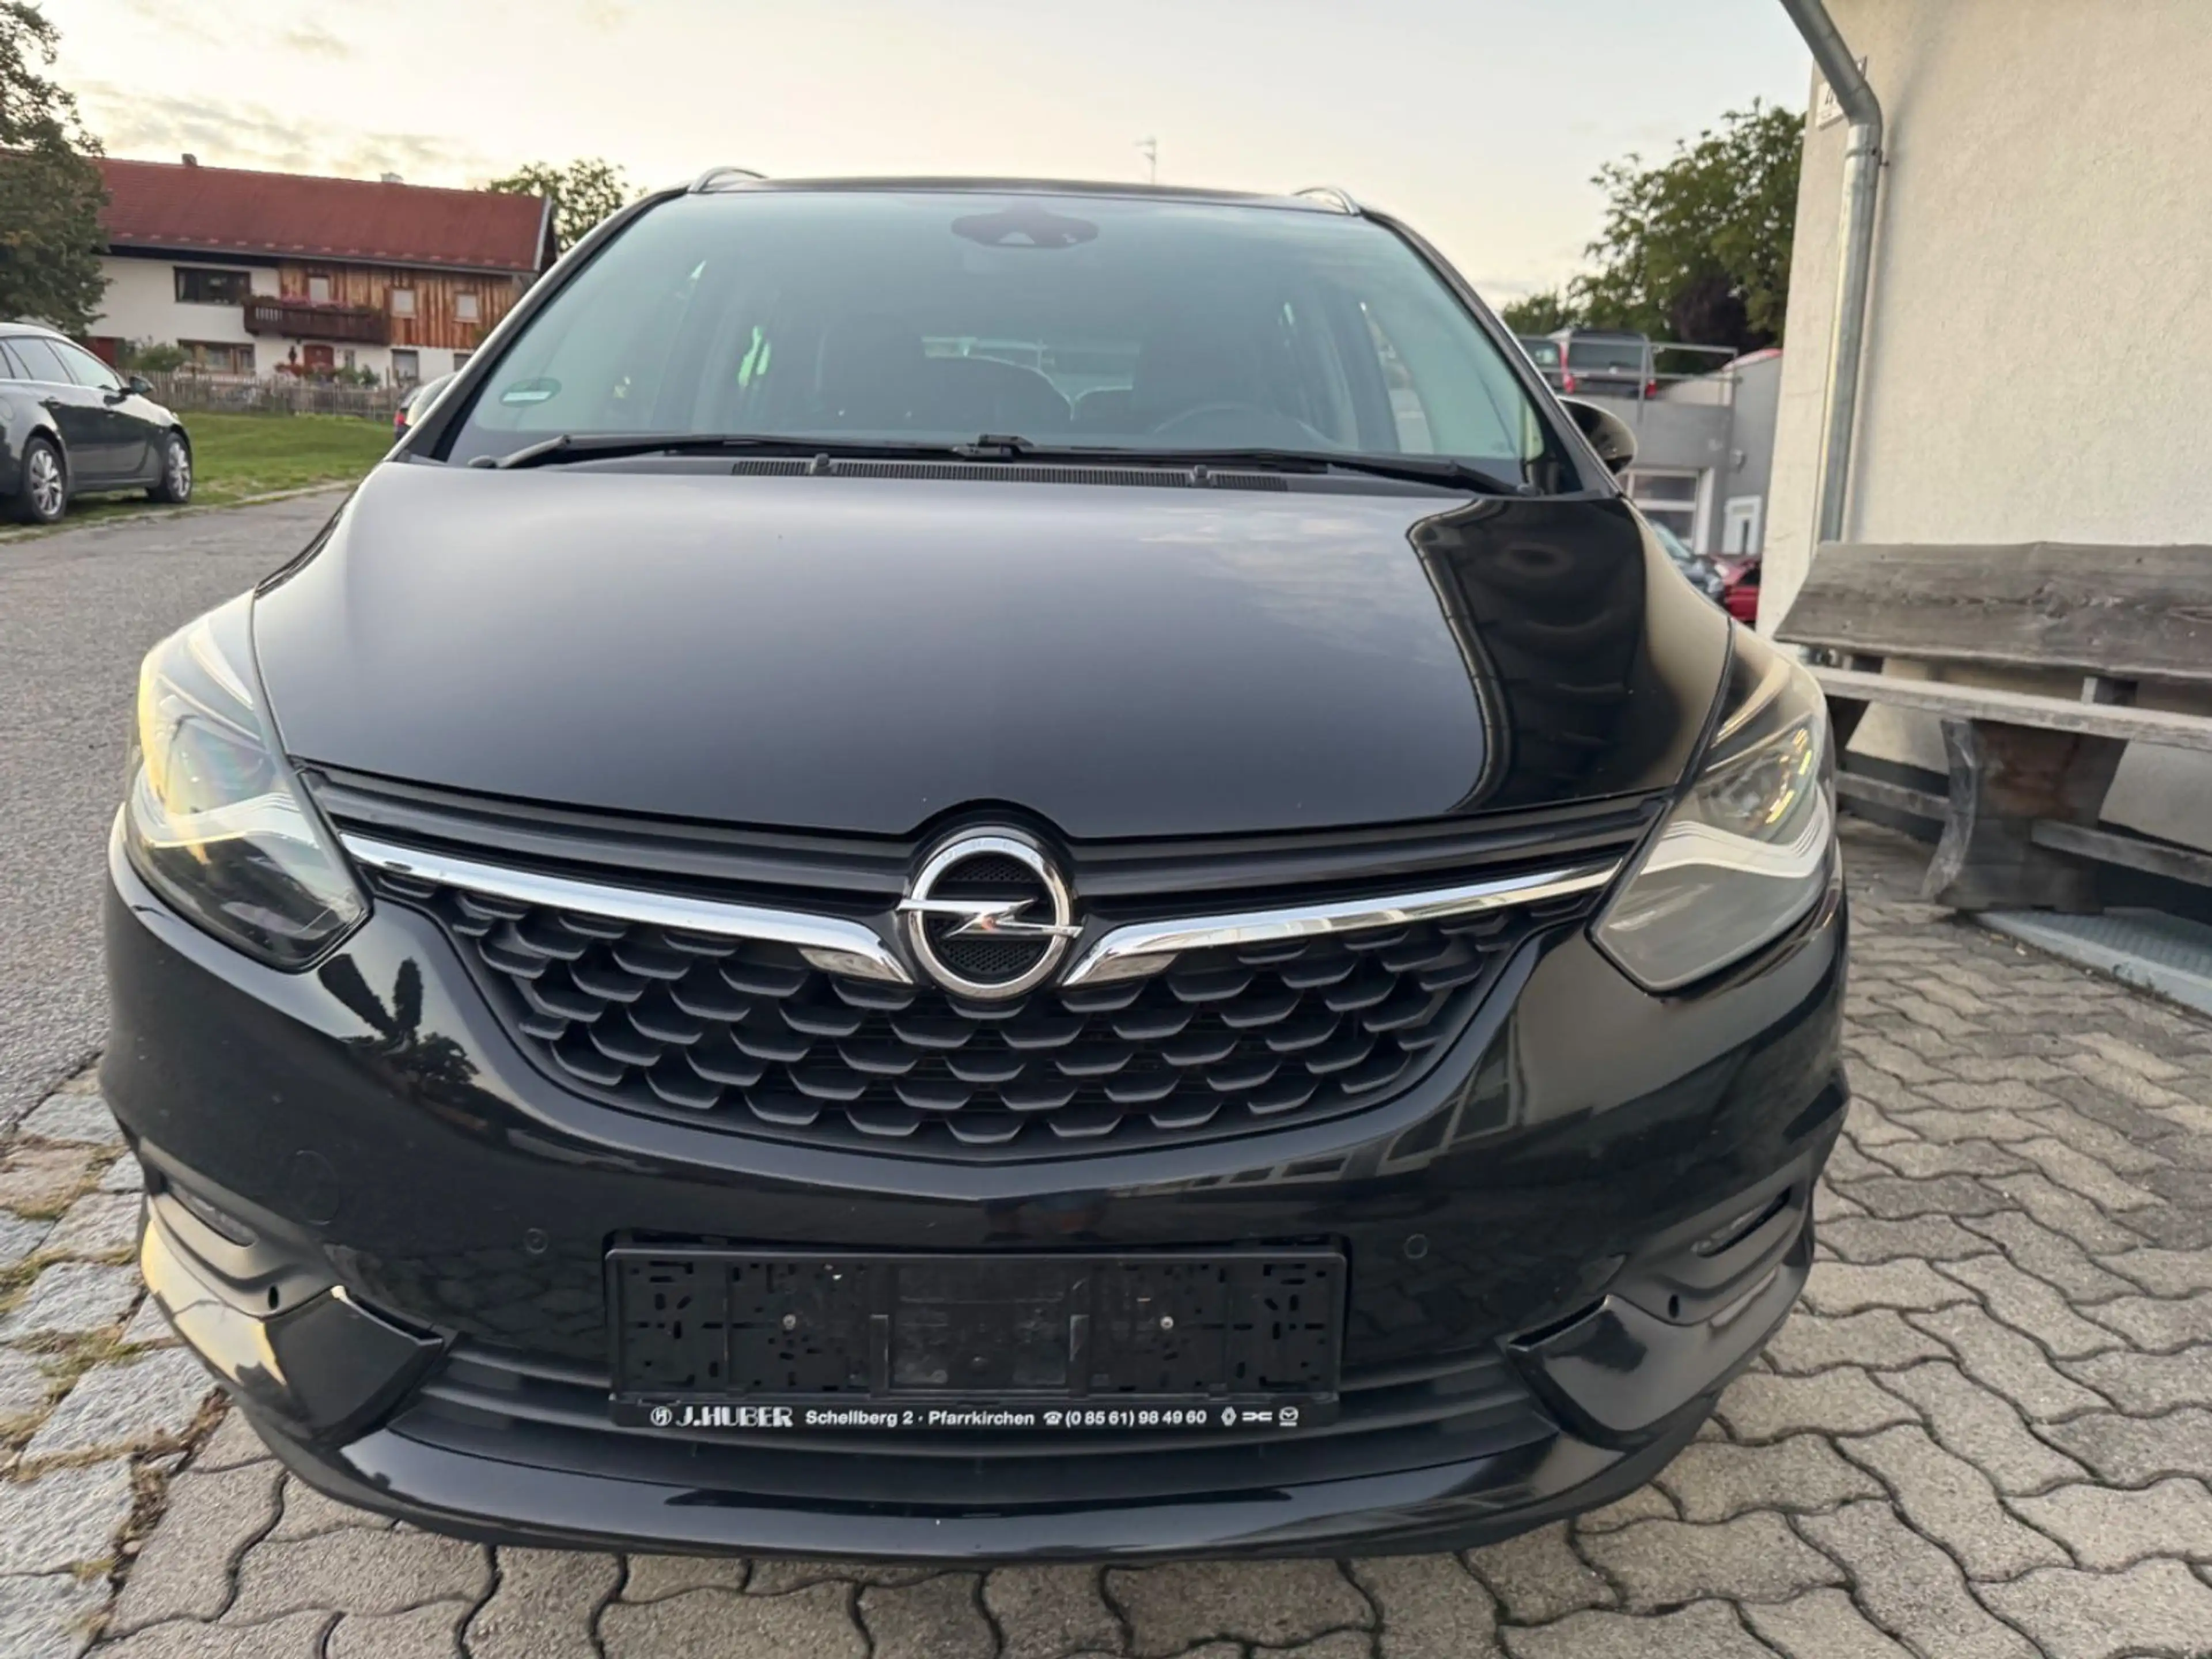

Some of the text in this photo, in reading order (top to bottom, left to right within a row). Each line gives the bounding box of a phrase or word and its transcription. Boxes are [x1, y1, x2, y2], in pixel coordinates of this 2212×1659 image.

[675, 1406, 794, 1427] J.HUBER
[805, 1410, 898, 1429] Schellberg
[902, 1410, 914, 1425] 2
[928, 1410, 1035, 1426] Pfarrkirchen
[1064, 1410, 1082, 1428] (0
[1084, 1410, 1106, 1426] 85
[1108, 1410, 1135, 1427] 61)
[1138, 1410, 1160, 1425] 98
[1161, 1410, 1183, 1425] 49
[1185, 1410, 1207, 1425] 60
